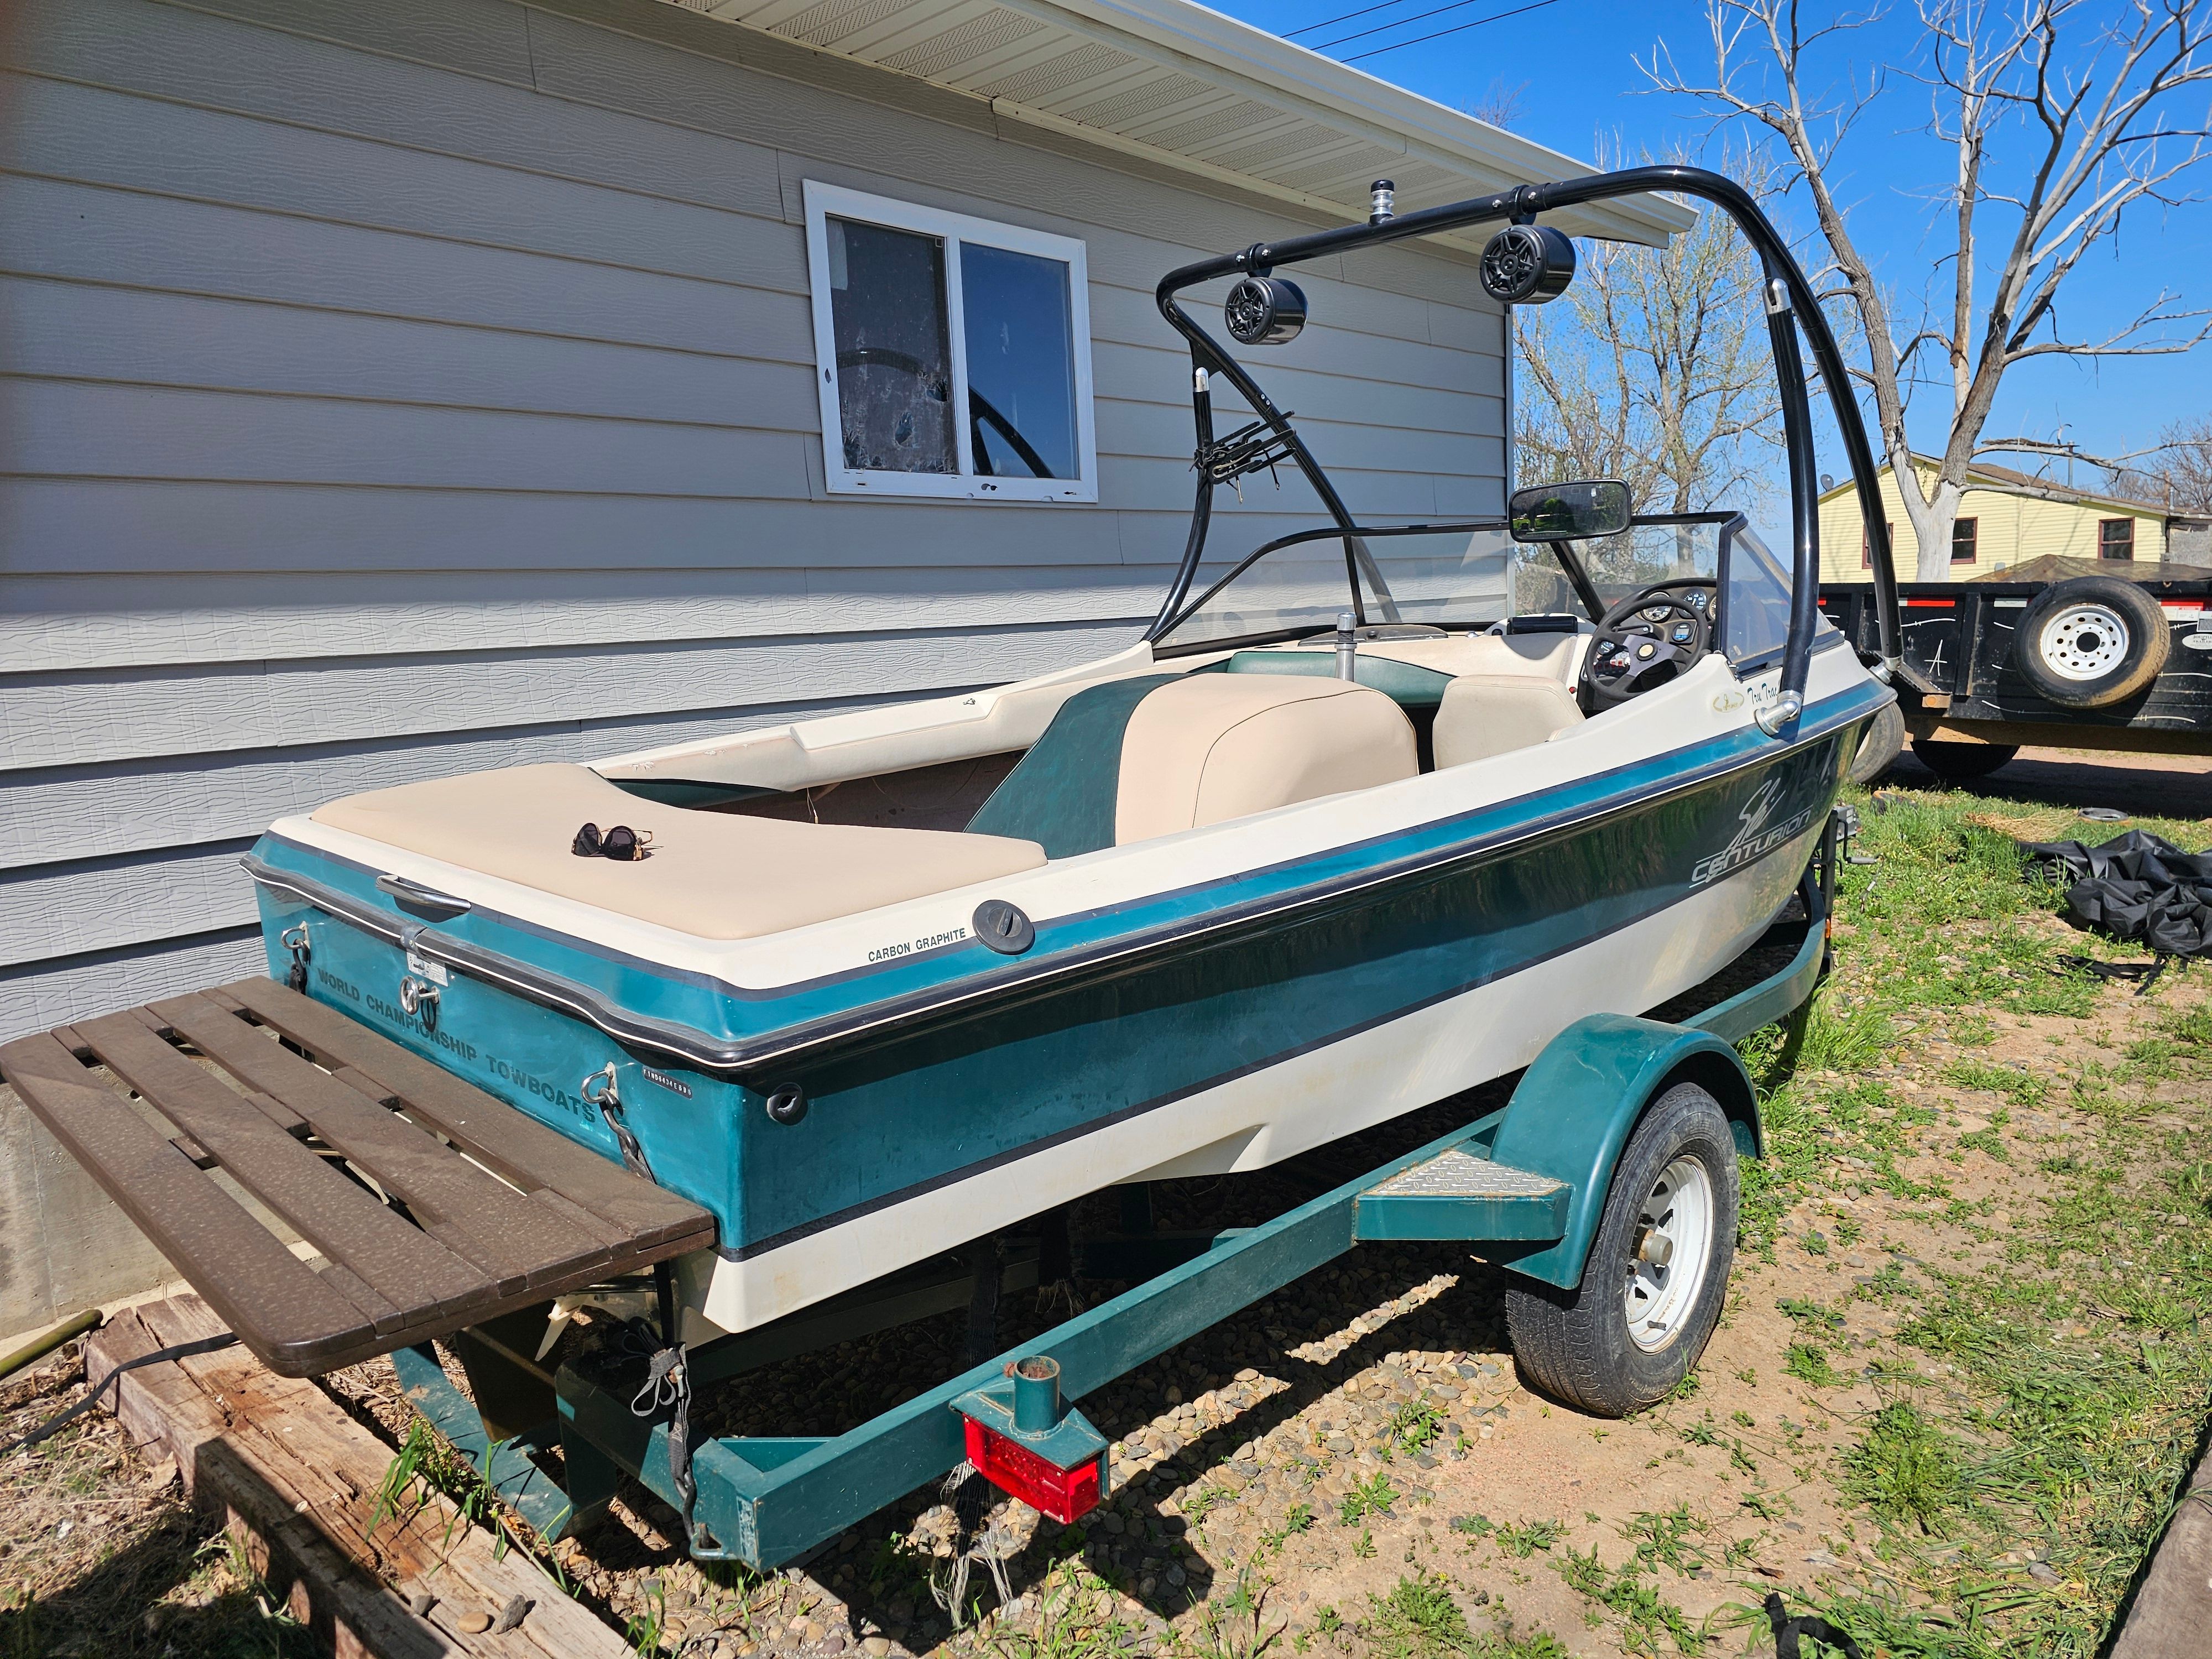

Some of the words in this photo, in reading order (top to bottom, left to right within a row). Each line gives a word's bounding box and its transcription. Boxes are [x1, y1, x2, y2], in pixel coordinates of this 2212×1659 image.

[1747, 687, 1761, 705] Tru
[1692, 810, 1811, 882] CENTURION
[868, 942, 910, 962] CARBON
[916, 928, 966, 950] GRAPHITE
[317, 968, 360, 1001] WORLD
[366, 994, 477, 1061] CHAMPIONSHIP
[486, 1054, 596, 1123] TOWBOATS
